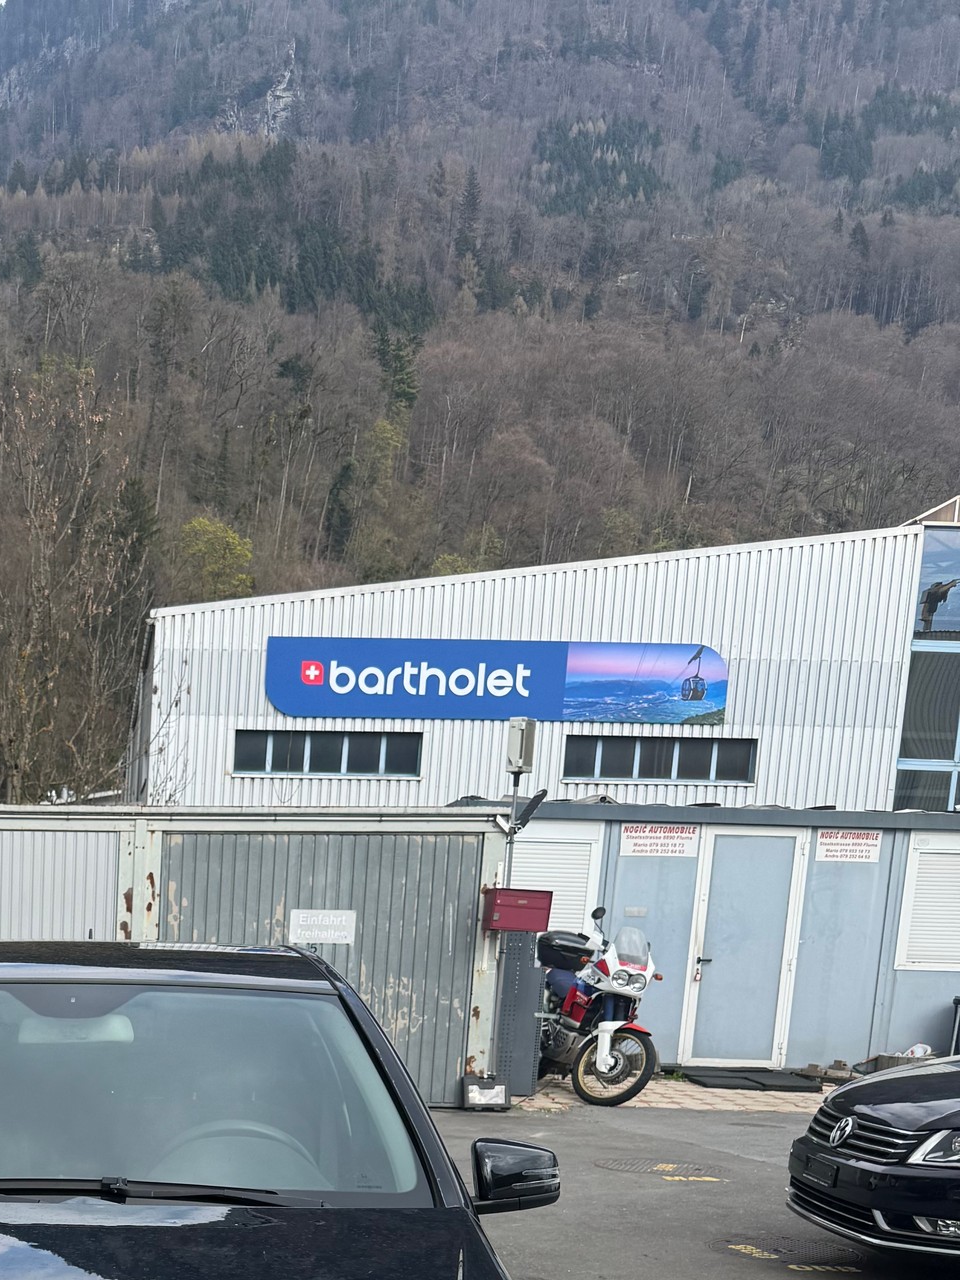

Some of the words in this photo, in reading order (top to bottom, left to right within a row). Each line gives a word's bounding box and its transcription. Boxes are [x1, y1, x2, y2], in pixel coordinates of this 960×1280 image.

[329, 660, 531, 697] bartholet
[648, 826, 697, 834] AUTOMOBILE
[840, 832, 880, 840] AUTOMOBILE
[299, 914, 346, 925] Einfahrt
